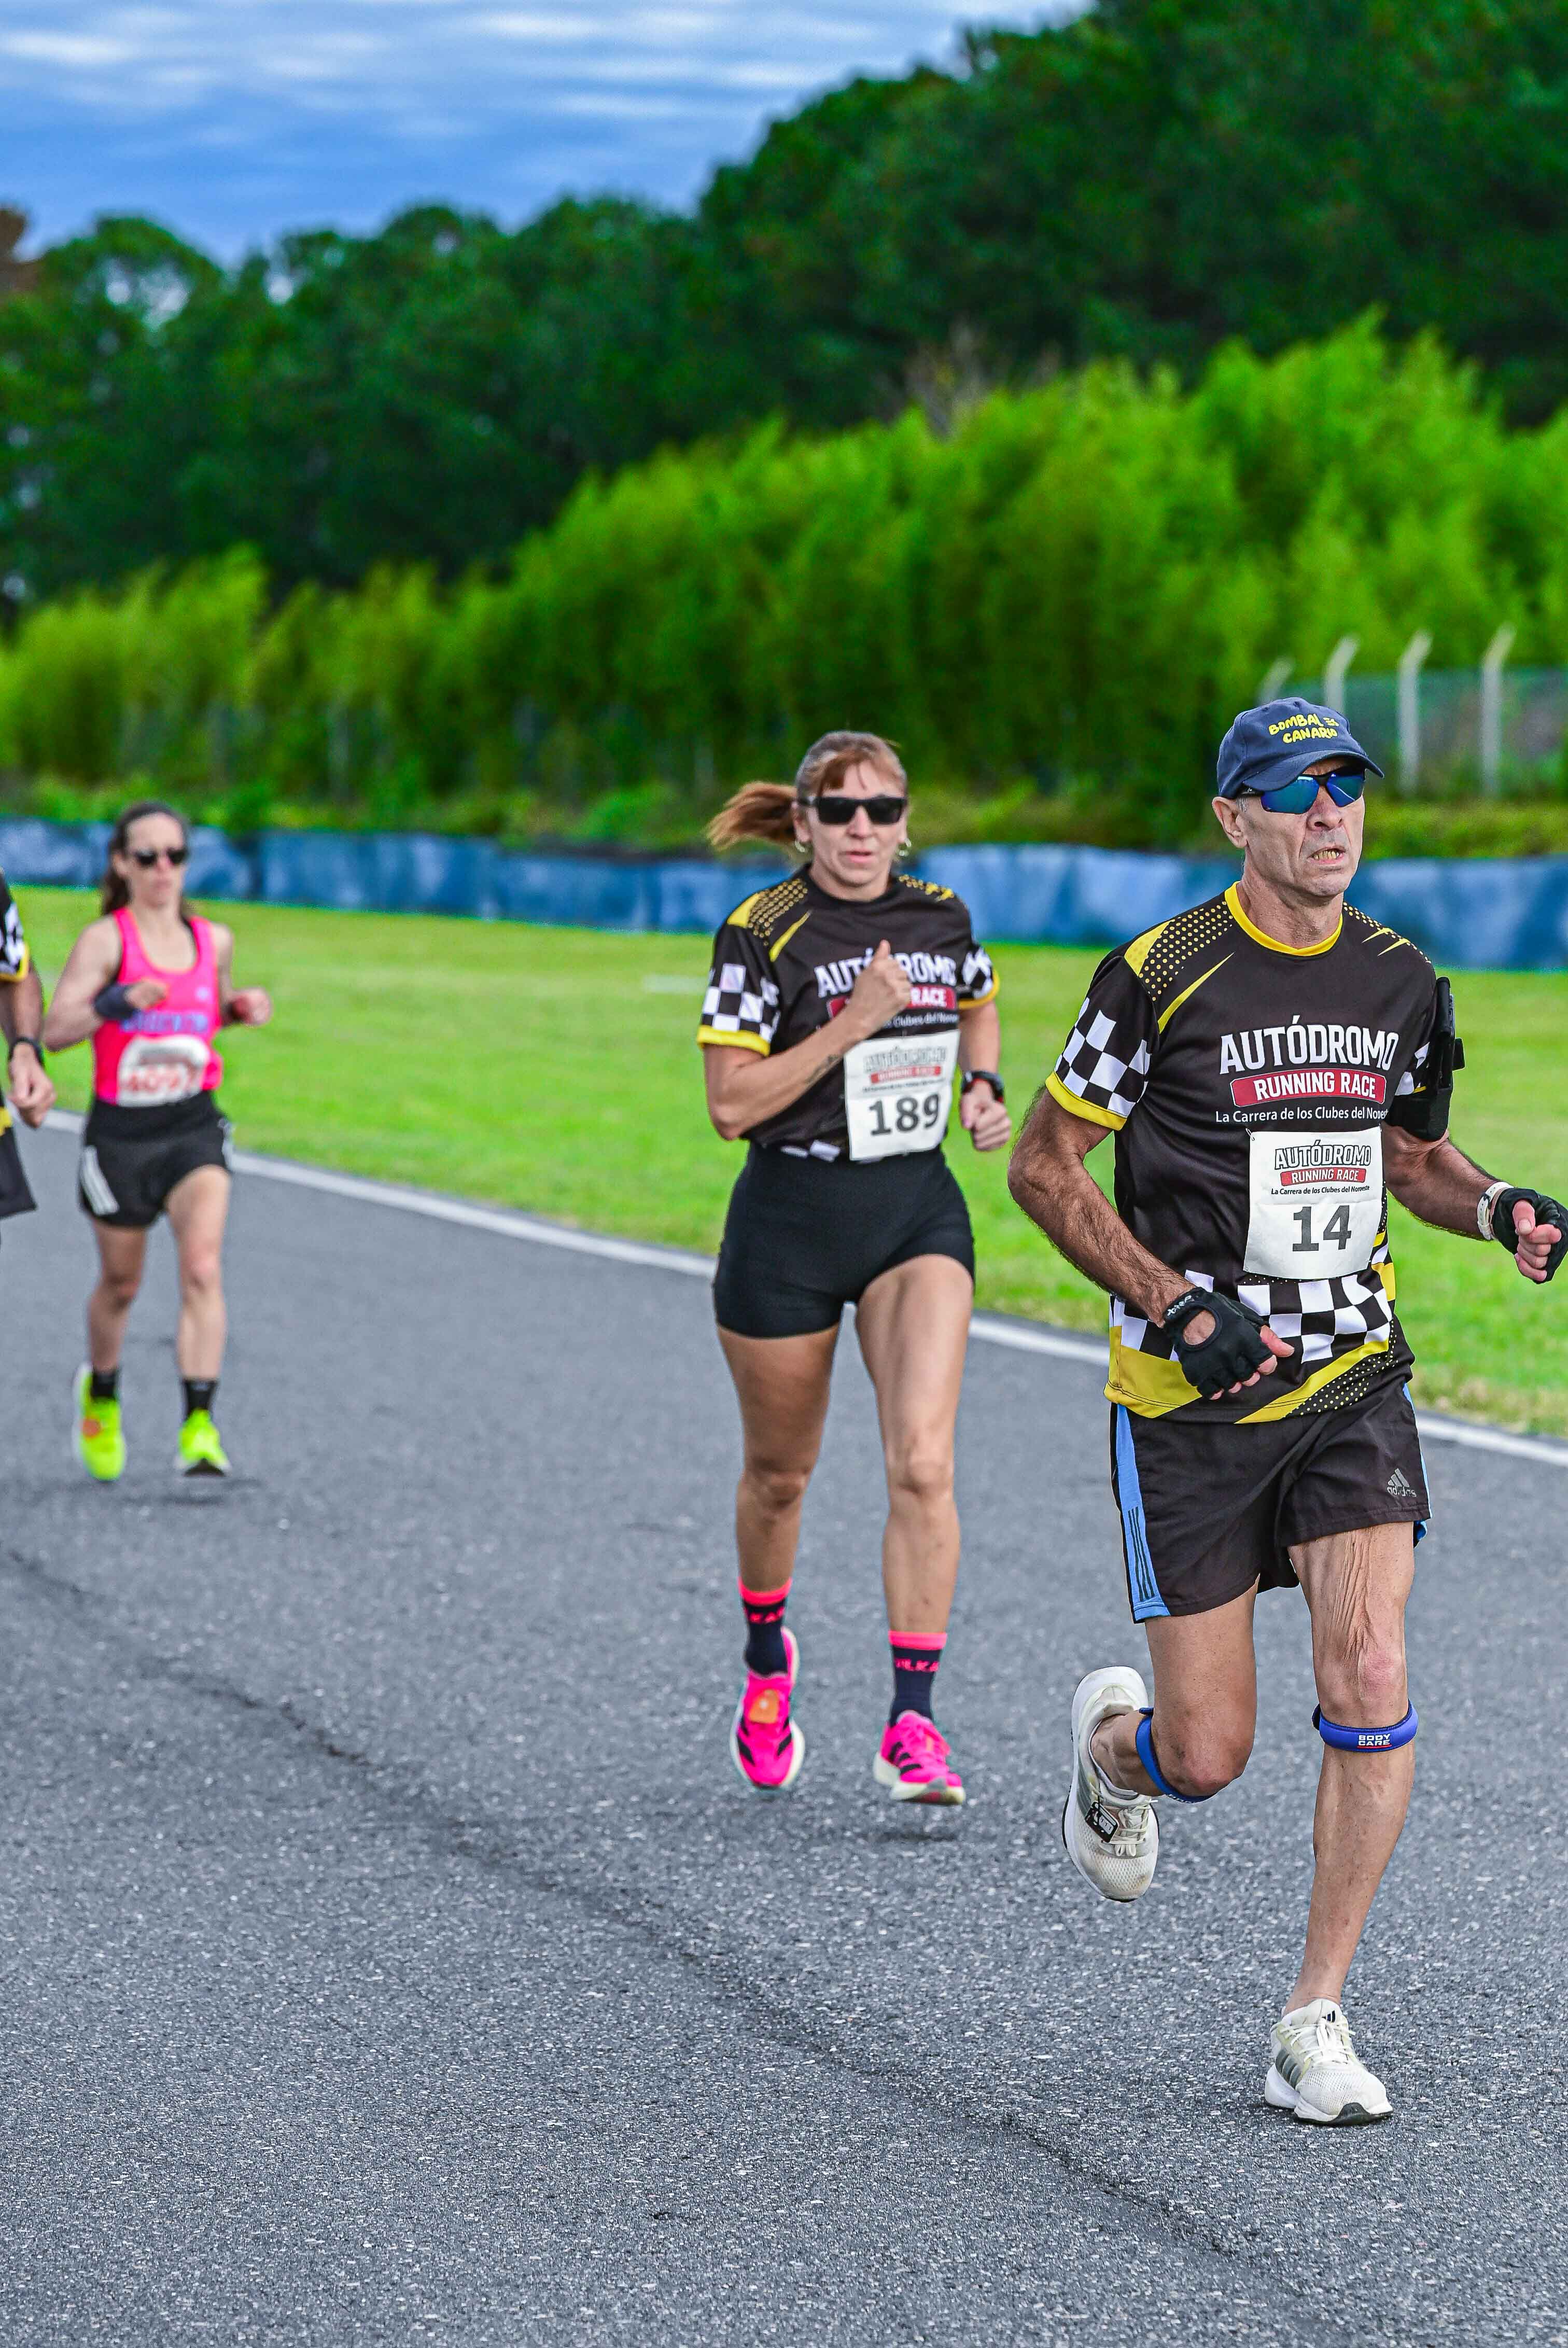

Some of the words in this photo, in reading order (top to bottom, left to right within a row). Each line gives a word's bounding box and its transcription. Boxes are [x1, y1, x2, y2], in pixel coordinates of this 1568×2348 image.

[1268, 714, 1324, 735] BOMBAL
[1282, 727, 1338, 744] CANARIO
[911, 987, 947, 1008] RACE
[1220, 1015, 1399, 1075] AUTÓDROMO
[1253, 1071, 1335, 1101] RUNNING
[1340, 1072, 1376, 1099] RACE
[869, 1094, 940, 1136] 189
[1216, 1111, 1229, 1123] La
[1233, 1110, 1277, 1123] Carrera
[1280, 1108, 1294, 1120] de
[1297, 1107, 1312, 1120] los
[1315, 1106, 1349, 1120] Clubes
[1351, 1106, 1365, 1119] del
[1275, 1140, 1371, 1170] AUTÓDROMO
[1291, 1169, 1334, 1183] RUNNING
[1336, 1169, 1359, 1181] RACE
[1293, 1205, 1352, 1252] 14
